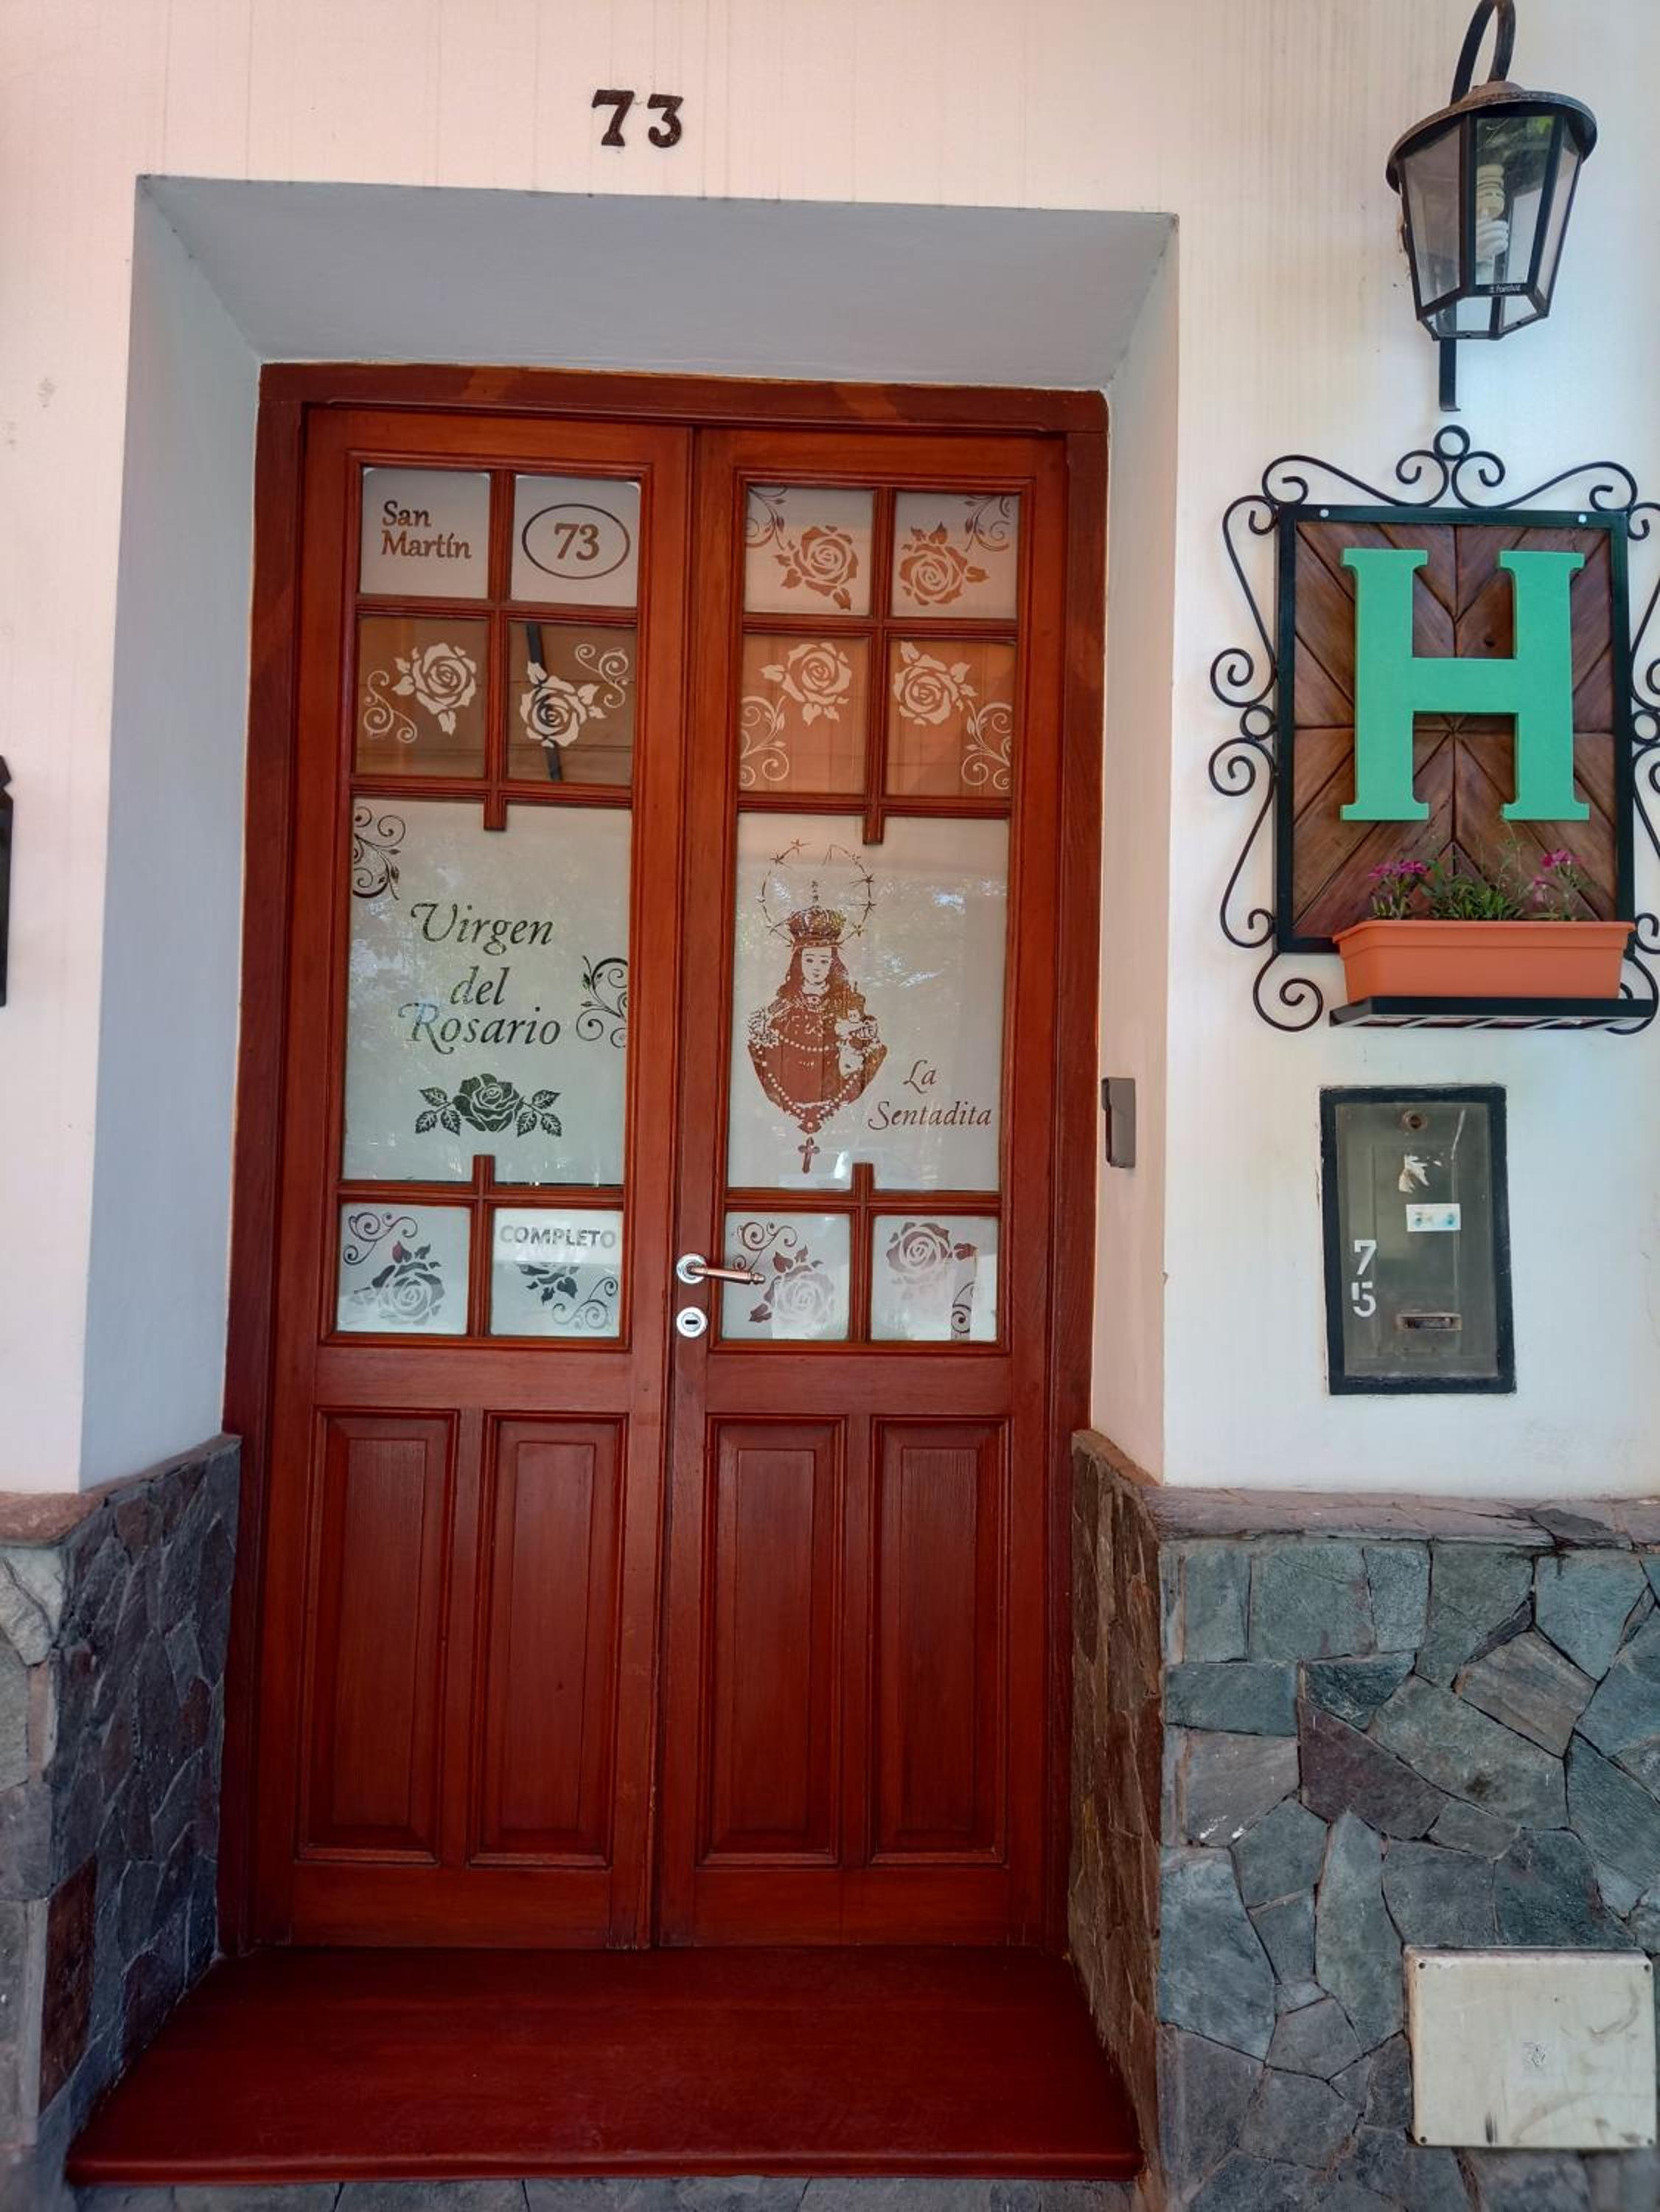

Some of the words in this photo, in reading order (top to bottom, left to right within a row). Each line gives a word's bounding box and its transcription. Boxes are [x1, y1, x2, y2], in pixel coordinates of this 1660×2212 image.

[592, 89, 684, 147] 73
[382, 500, 430, 527] San
[381, 529, 472, 560] Martín
[554, 523, 599, 561] 73
[1340, 548, 1590, 821] H
[411, 903, 553, 956] Virgen
[450, 965, 509, 1005] del
[399, 1003, 561, 1054] Rosario
[903, 1060, 936, 1094] La
[868, 1101, 991, 1130] Sentadita
[500, 1225, 615, 1248] COMPLETO
